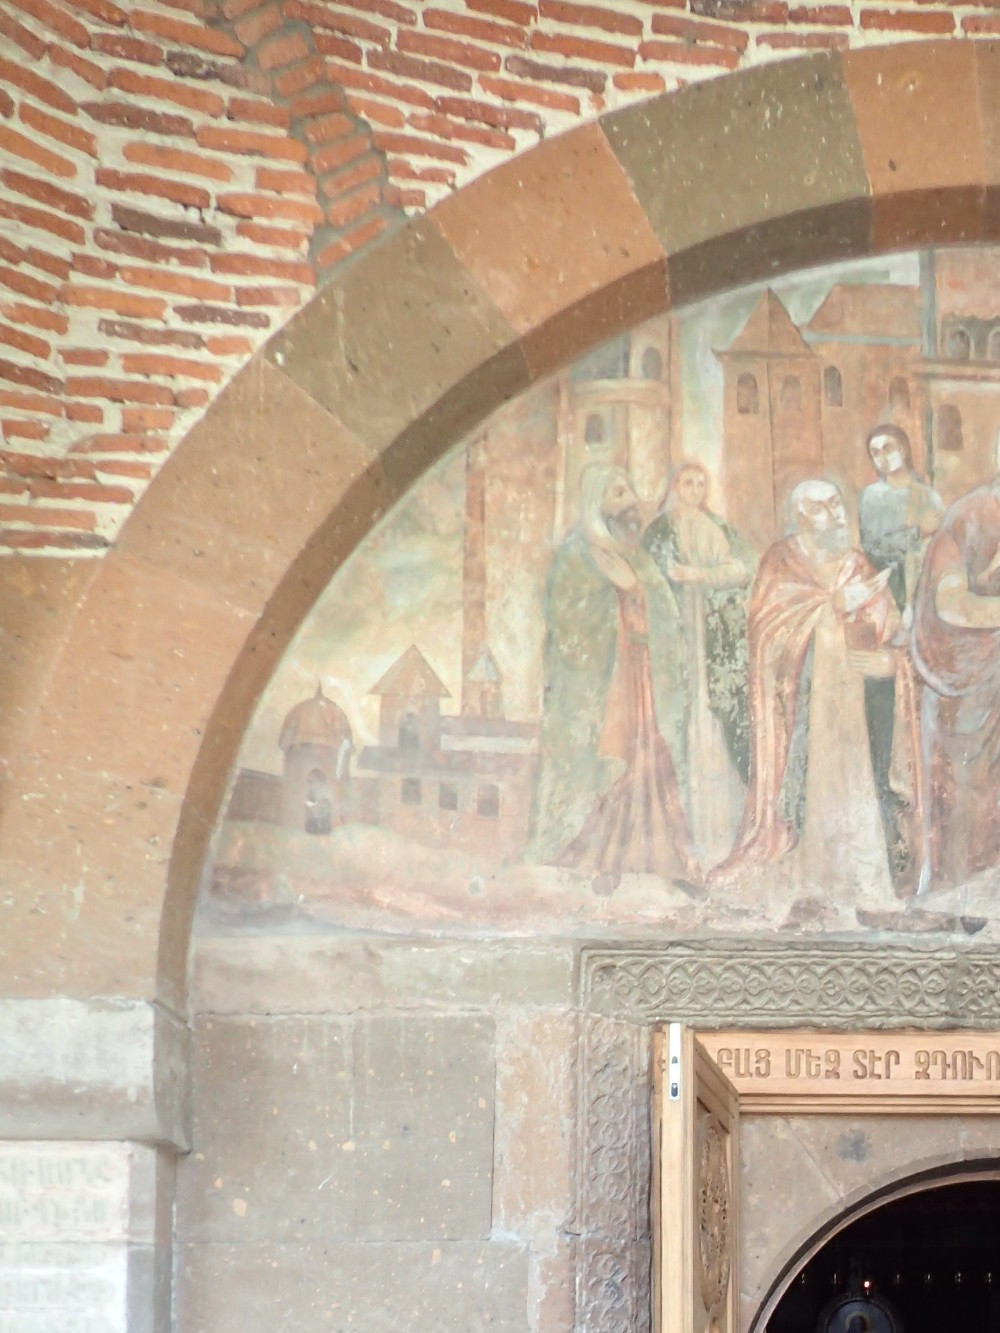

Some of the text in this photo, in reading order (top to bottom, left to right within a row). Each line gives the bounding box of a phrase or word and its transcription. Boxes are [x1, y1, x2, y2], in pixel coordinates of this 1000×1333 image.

[716, 1047, 771, 1079] ԲԱՑ
[785, 1048, 841, 1080] ՄԵԶ
[852, 1049, 900, 1080] ՏԷՐ
